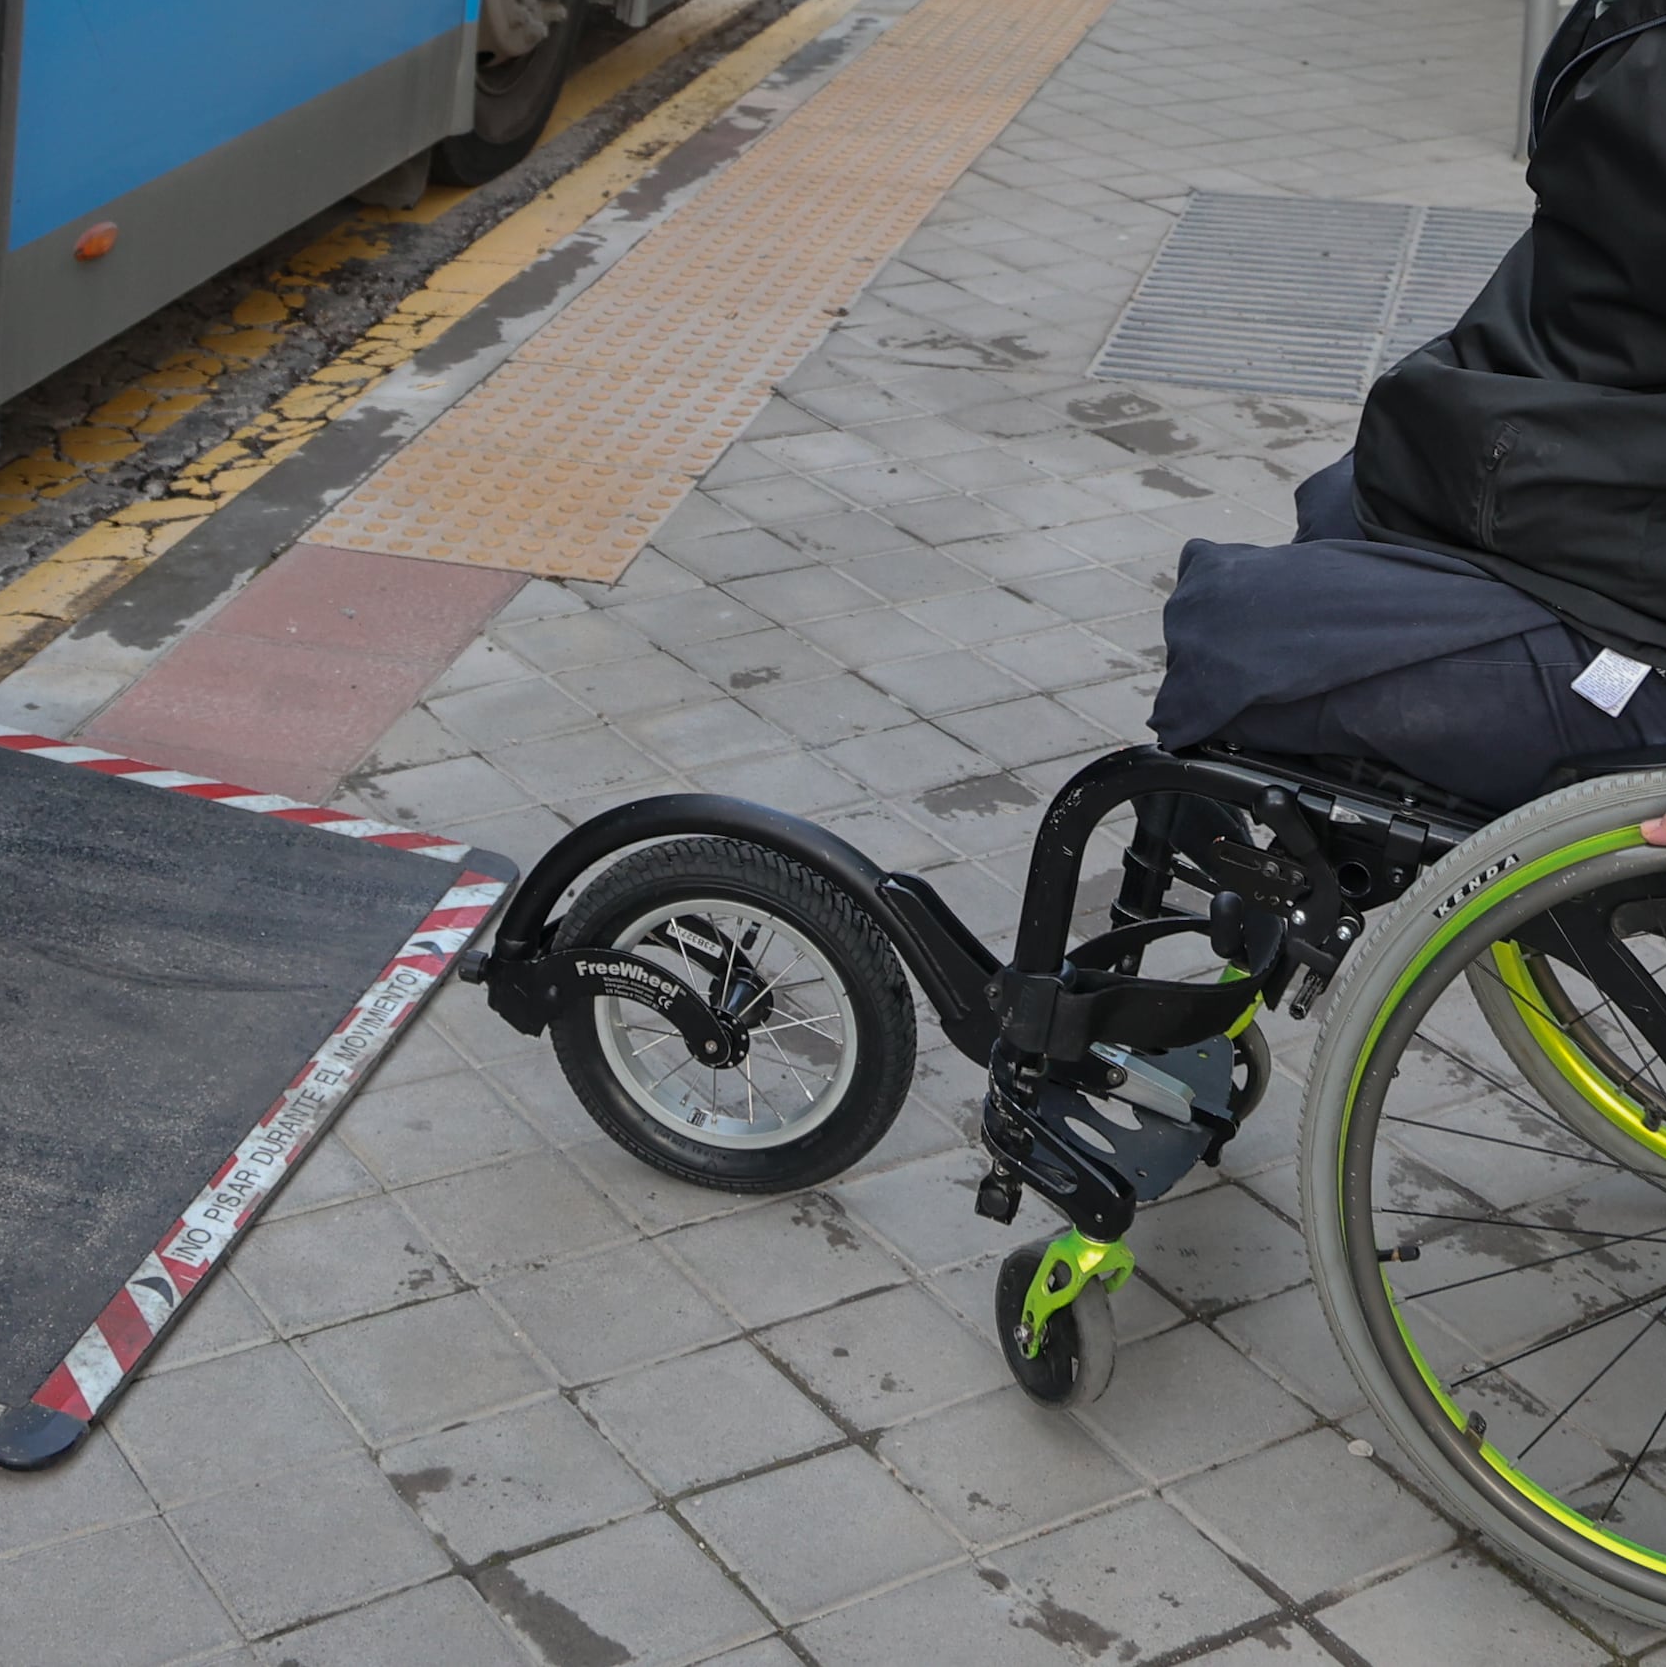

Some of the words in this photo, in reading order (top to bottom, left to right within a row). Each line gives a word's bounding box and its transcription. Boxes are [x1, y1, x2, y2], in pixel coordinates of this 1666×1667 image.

[1437, 853, 1519, 918] KENDA
[575, 960, 680, 999] FreeWheel
[204, 1168, 262, 1225] PISAR
[250, 1087, 325, 1169] DURANTE
[315, 1064, 346, 1088] EL
[334, 967, 419, 1063] MOVIMIENTO!
